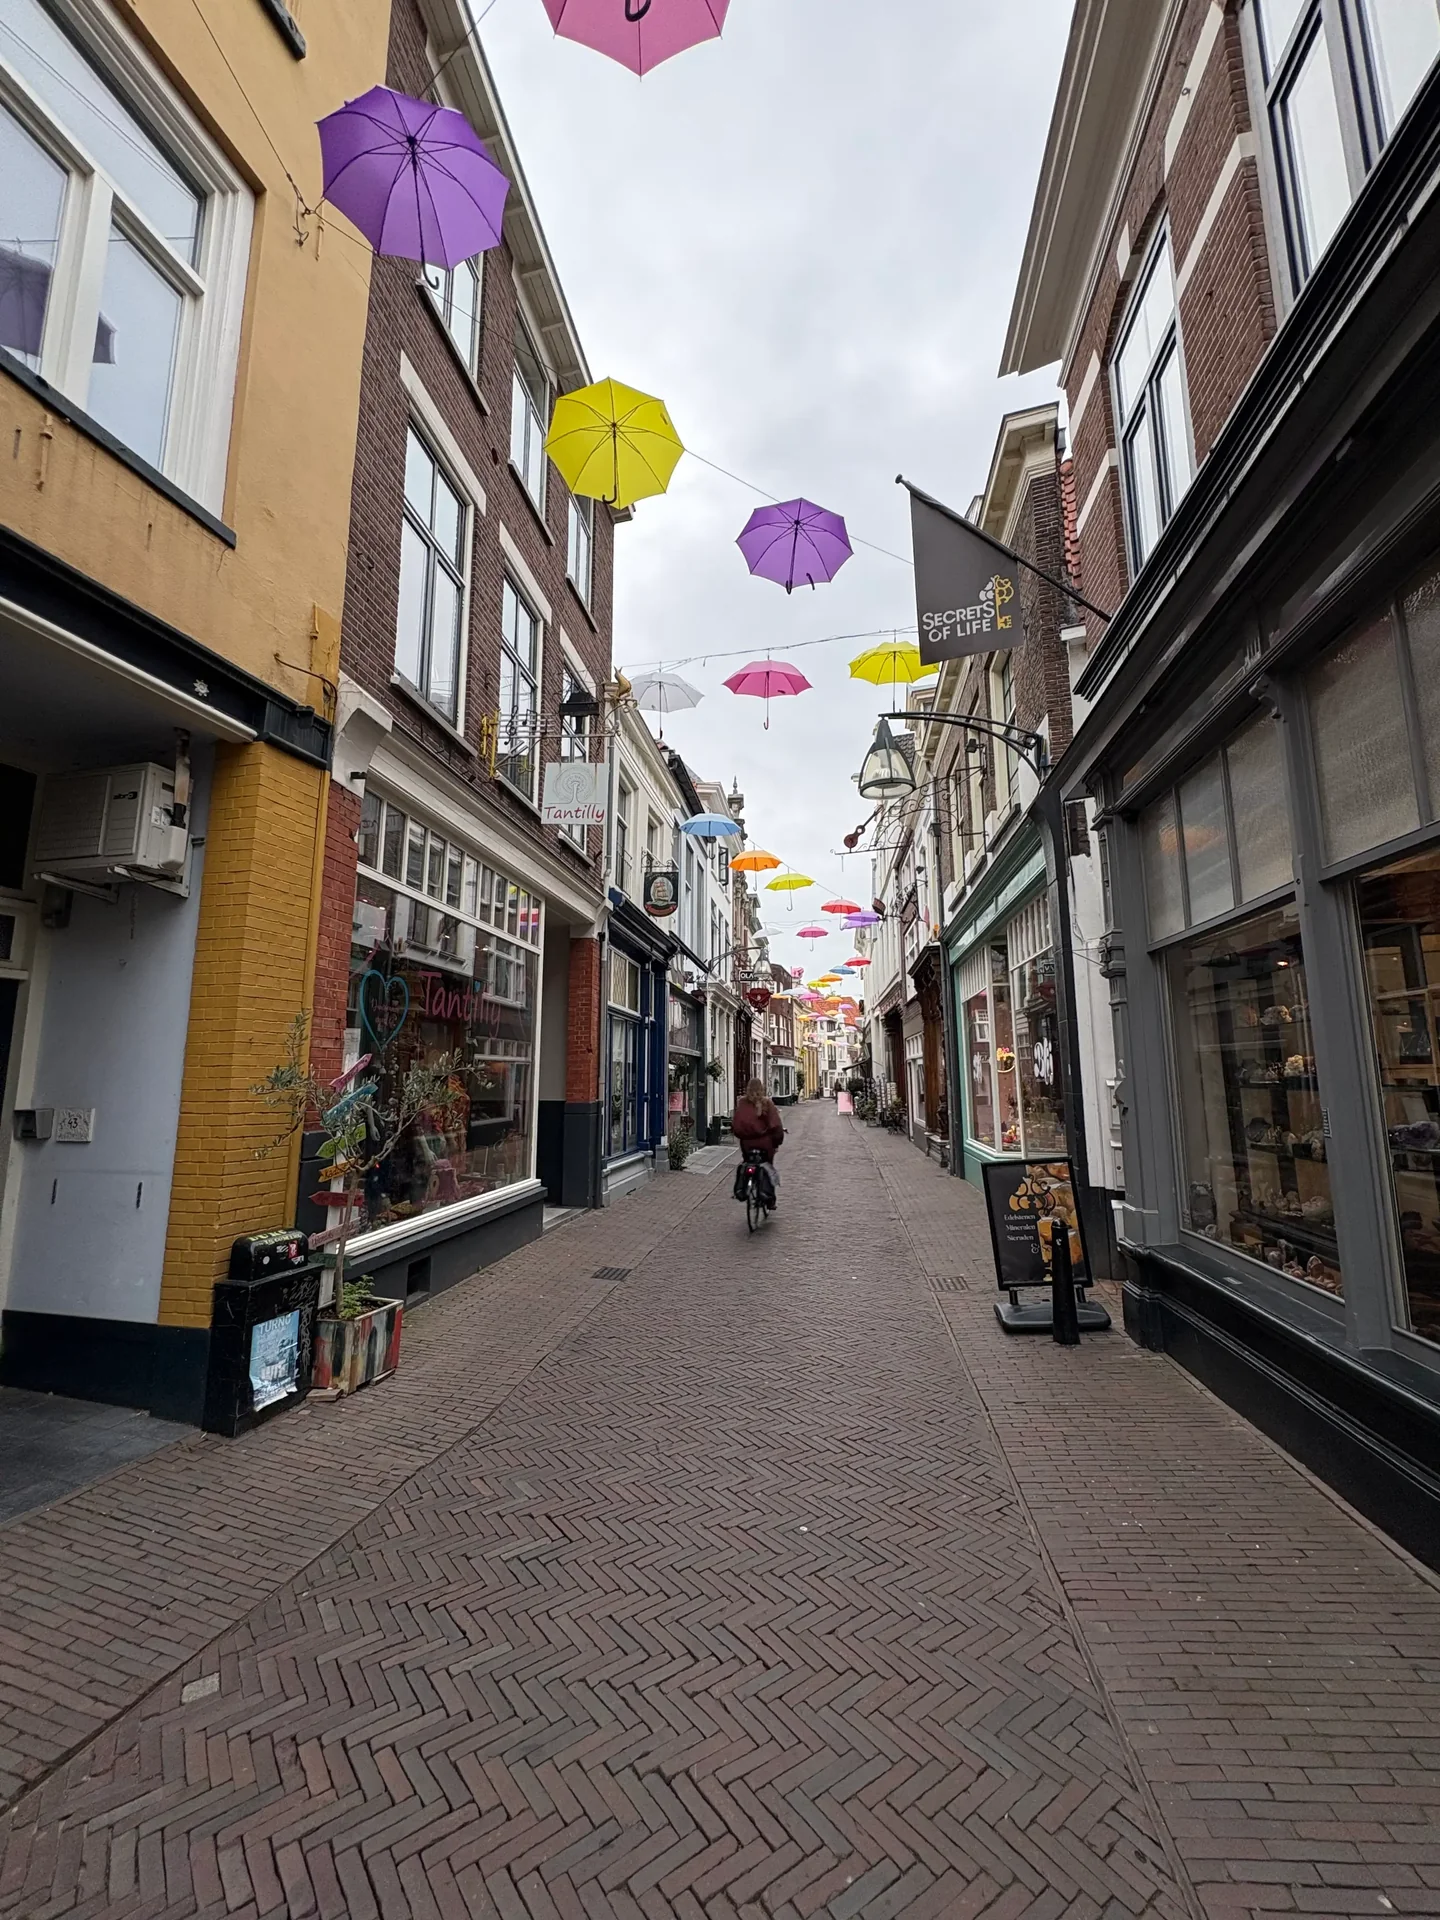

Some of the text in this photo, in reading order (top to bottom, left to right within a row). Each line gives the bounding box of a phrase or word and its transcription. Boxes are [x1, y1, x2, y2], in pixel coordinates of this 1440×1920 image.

[922, 600, 995, 630] SECRETS
[928, 619, 991, 642] OF LIFE
[544, 804, 605, 823] Tantilly
[417, 970, 501, 1039] Tantilly
[67, 1117, 79, 1129] 43
[1031, 1243, 1040, 1254] &
